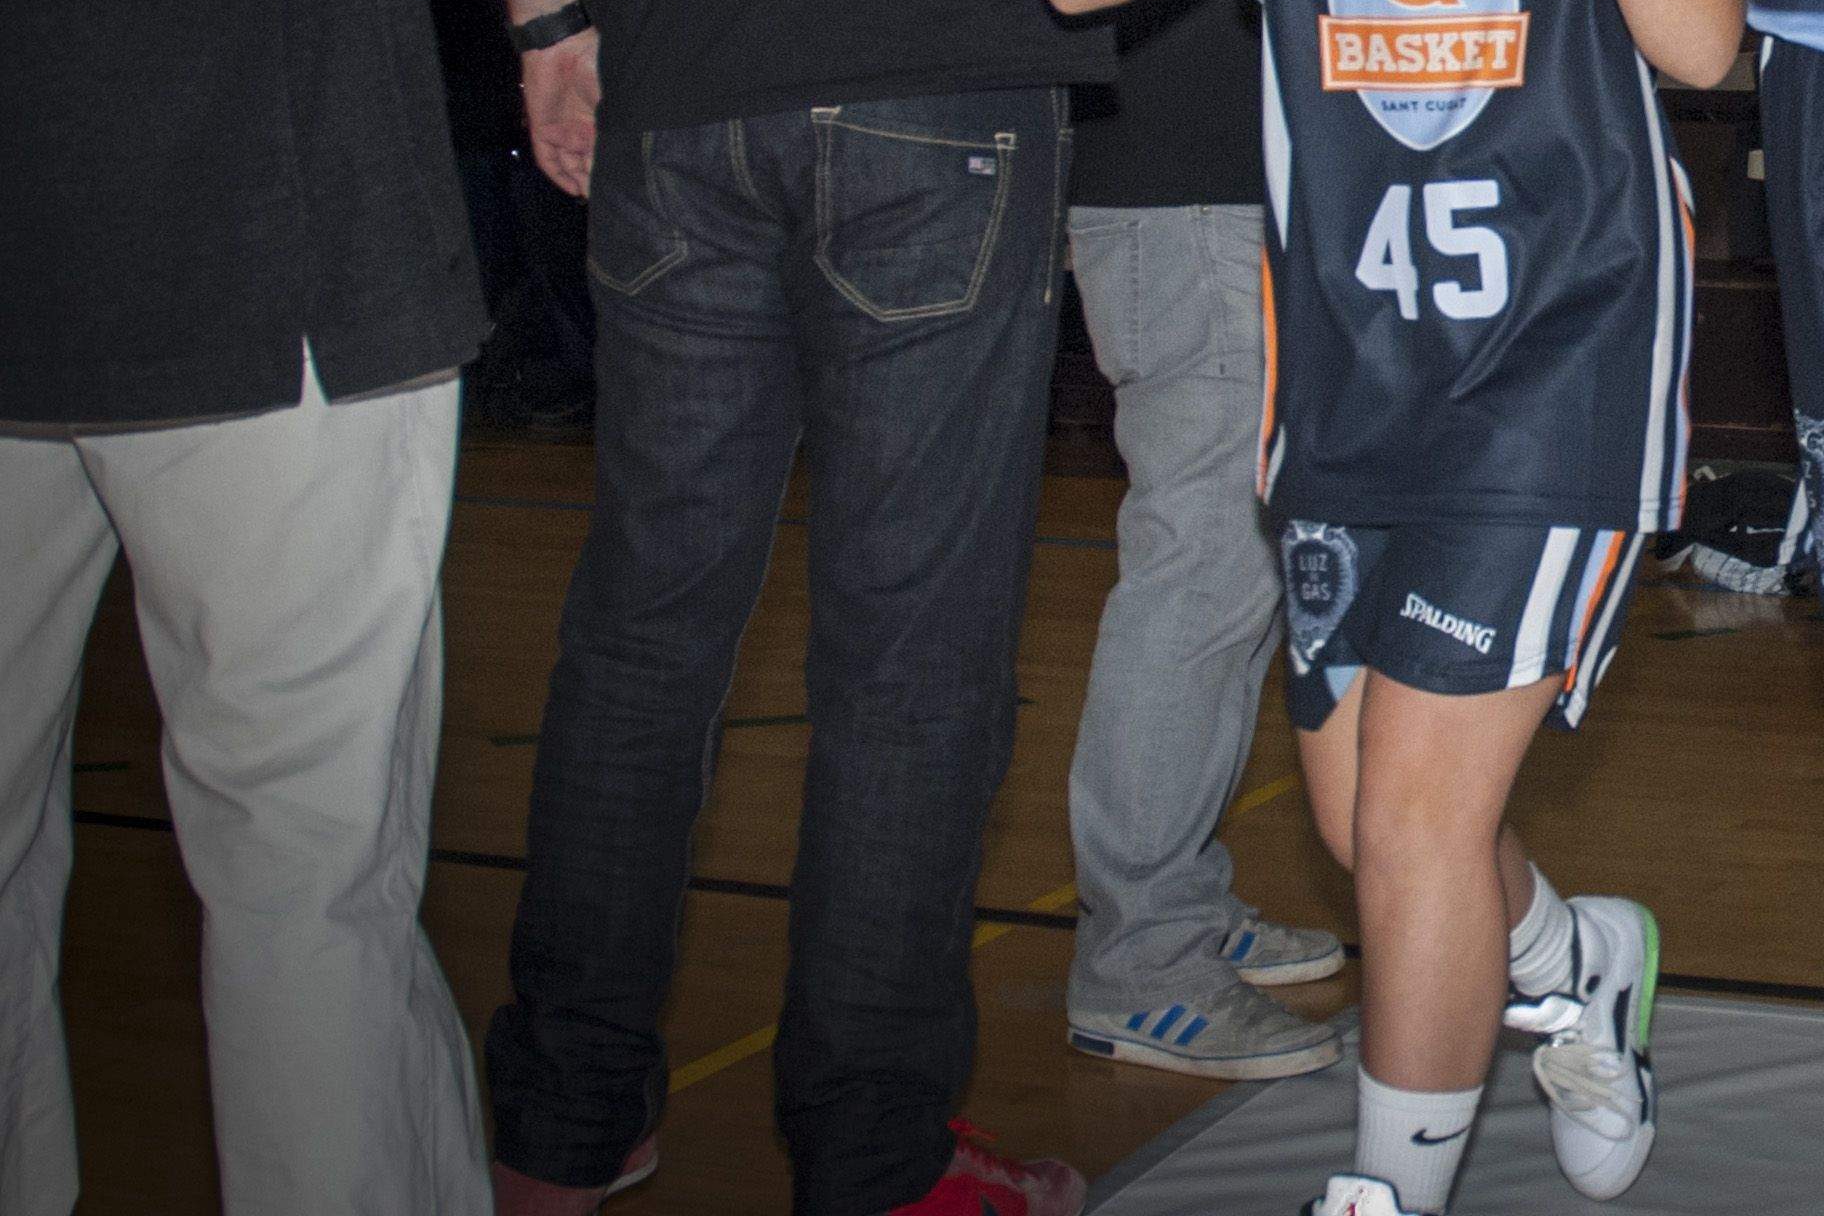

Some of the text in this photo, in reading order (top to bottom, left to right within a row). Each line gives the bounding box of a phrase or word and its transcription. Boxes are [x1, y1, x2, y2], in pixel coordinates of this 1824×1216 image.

[1335, 29, 1516, 74] BASKET
[1381, 100, 1419, 112] SANT
[1355, 180, 1509, 319] 45
[1400, 592, 1496, 654] SPALDING
